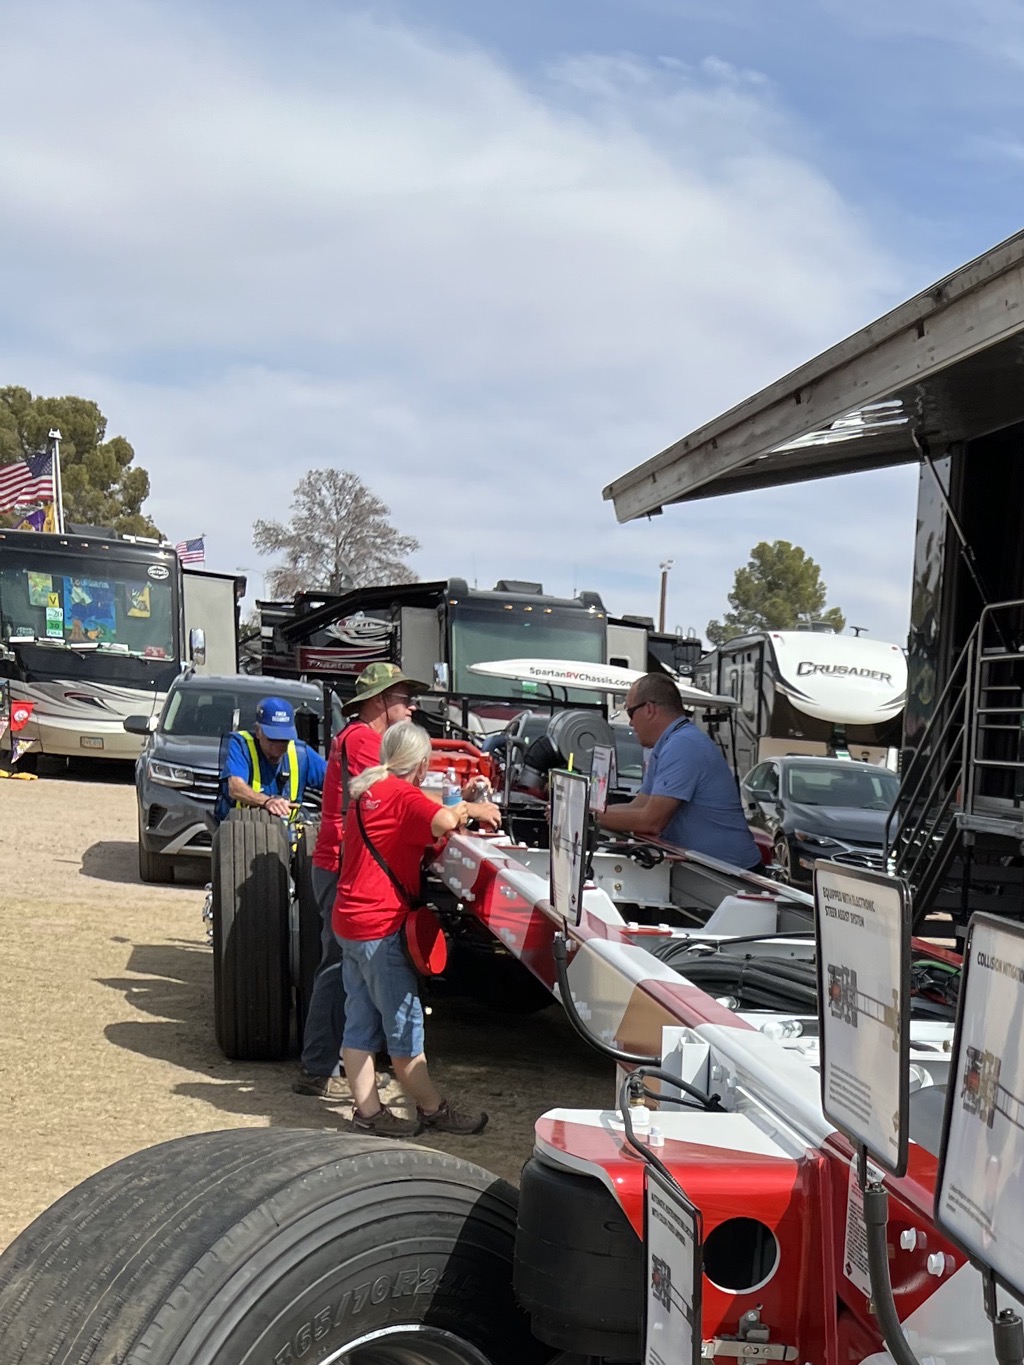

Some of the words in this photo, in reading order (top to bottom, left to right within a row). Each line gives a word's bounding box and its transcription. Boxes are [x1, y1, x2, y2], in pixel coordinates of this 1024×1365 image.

[529, 667, 634, 687] SpartanRVChassis.com
[796, 661, 894, 688] CRUSADER
[977, 951, 1003, 974] COLLISION
